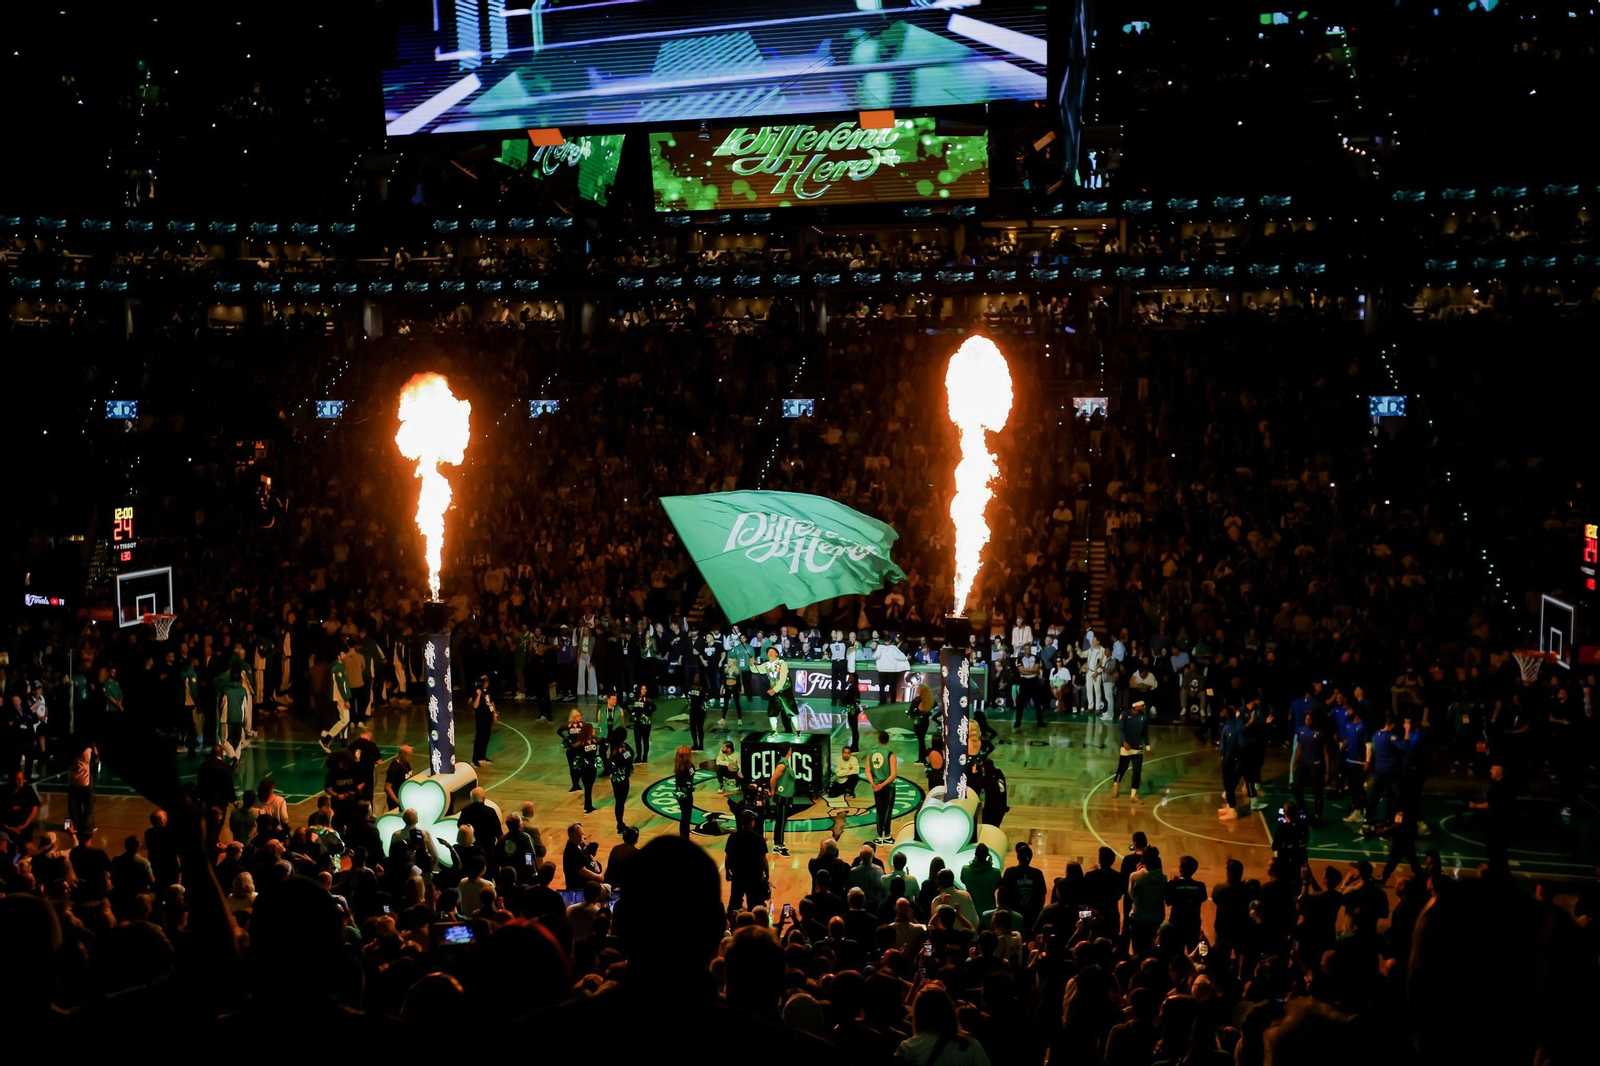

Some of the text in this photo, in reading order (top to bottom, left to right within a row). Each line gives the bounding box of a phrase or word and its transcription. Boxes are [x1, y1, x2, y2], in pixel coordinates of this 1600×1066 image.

[770, 150, 881, 200] Here
[115, 507, 133, 520] 12:00
[113, 519, 133, 541] 24
[751, 750, 812, 782] CELCS
